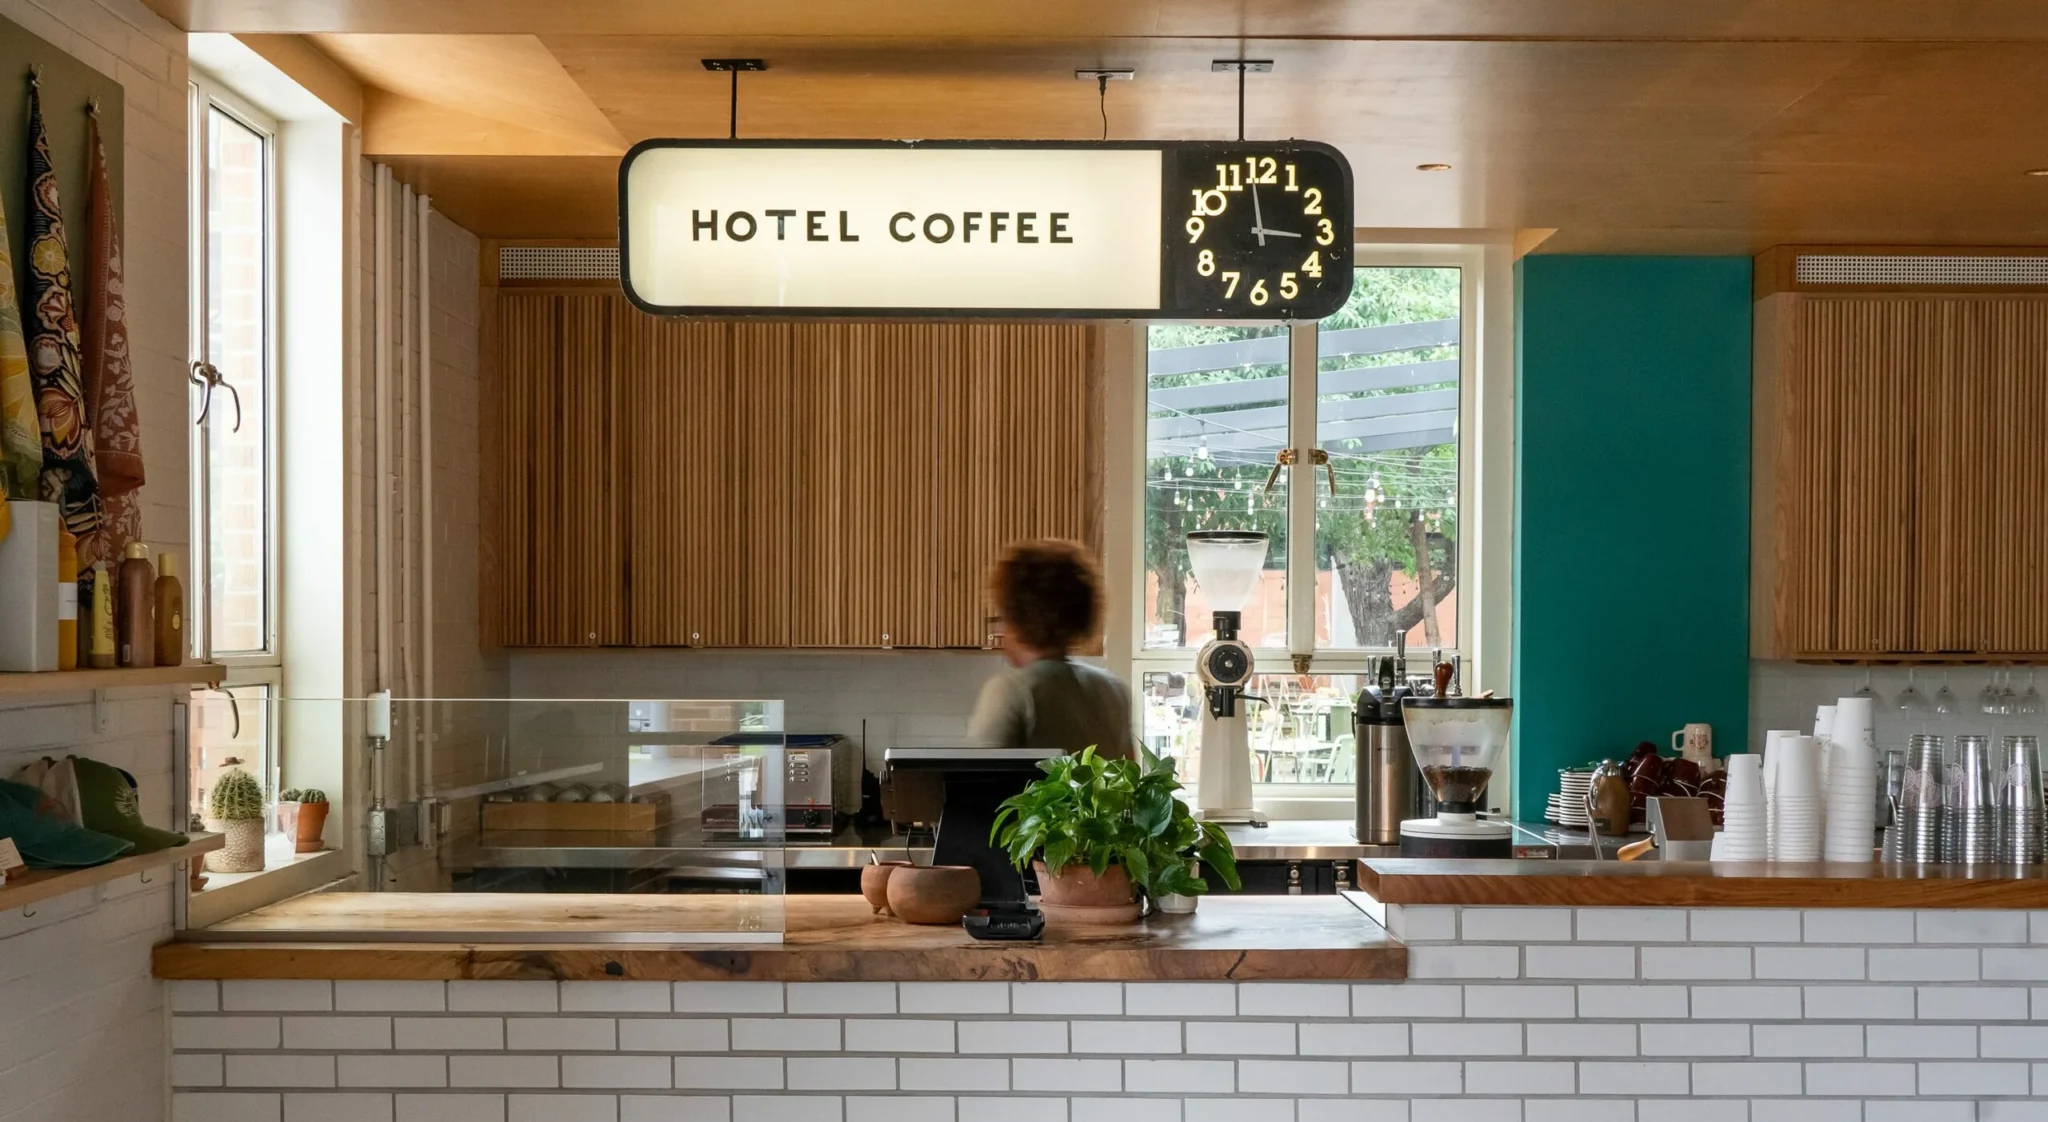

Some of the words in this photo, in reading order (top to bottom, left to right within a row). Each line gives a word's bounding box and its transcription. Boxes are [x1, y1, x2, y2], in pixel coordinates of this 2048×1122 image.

[1215, 164, 1243, 192] 11
[1245, 157, 1277, 184] 12
[1284, 164, 1299, 192] 1
[1191, 189, 1228, 217] 10
[1303, 187, 1322, 215] 2
[692, 209, 860, 242] HOTEL
[889, 211, 1074, 244] COFFEE
[1185, 216, 1205, 244] 9
[1315, 218, 1335, 246] 3
[1196, 249, 1216, 277] 8
[1301, 250, 1322, 278] 4
[1221, 271, 1241, 299] 7
[1249, 279, 1269, 306] 6
[1279, 272, 1299, 300] 5
